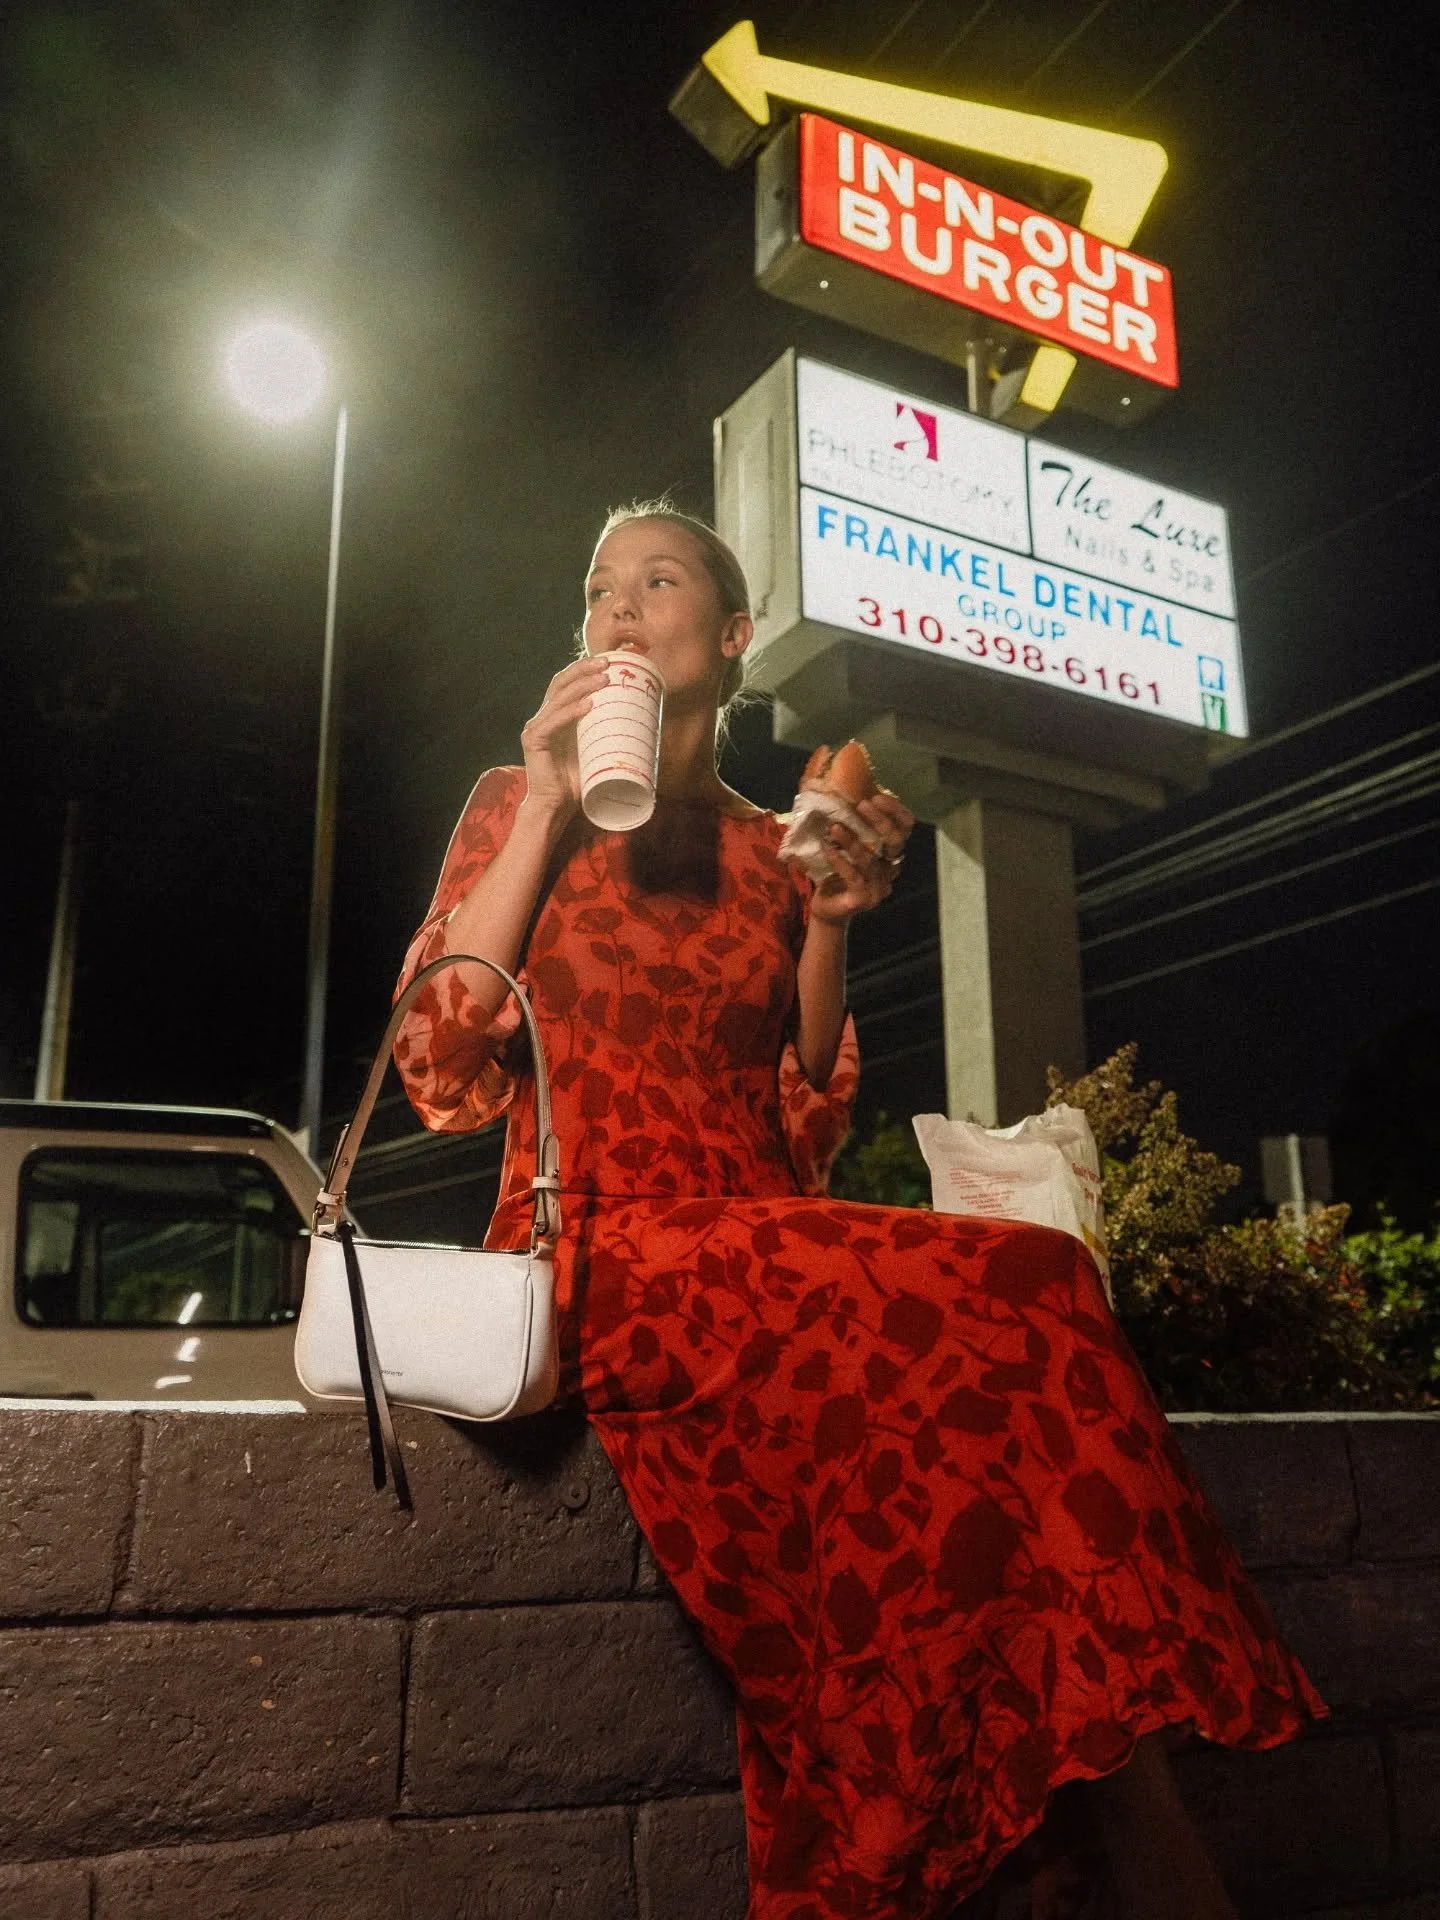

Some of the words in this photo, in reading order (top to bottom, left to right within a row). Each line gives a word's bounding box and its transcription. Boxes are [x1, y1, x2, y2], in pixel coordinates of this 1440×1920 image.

[837, 131, 1164, 307] IN-N-OUT
[838, 186, 1158, 364] BURGER
[1041, 460, 1112, 521] The
[817, 504, 1016, 597] FRANKEL
[1034, 573, 1183, 648] DENTAL
[1065, 524, 1129, 566] Nails
[1169, 558, 1215, 593] Spa
[857, 597, 1162, 706] 310-398-6161
[957, 593, 1067, 641] GROUP
